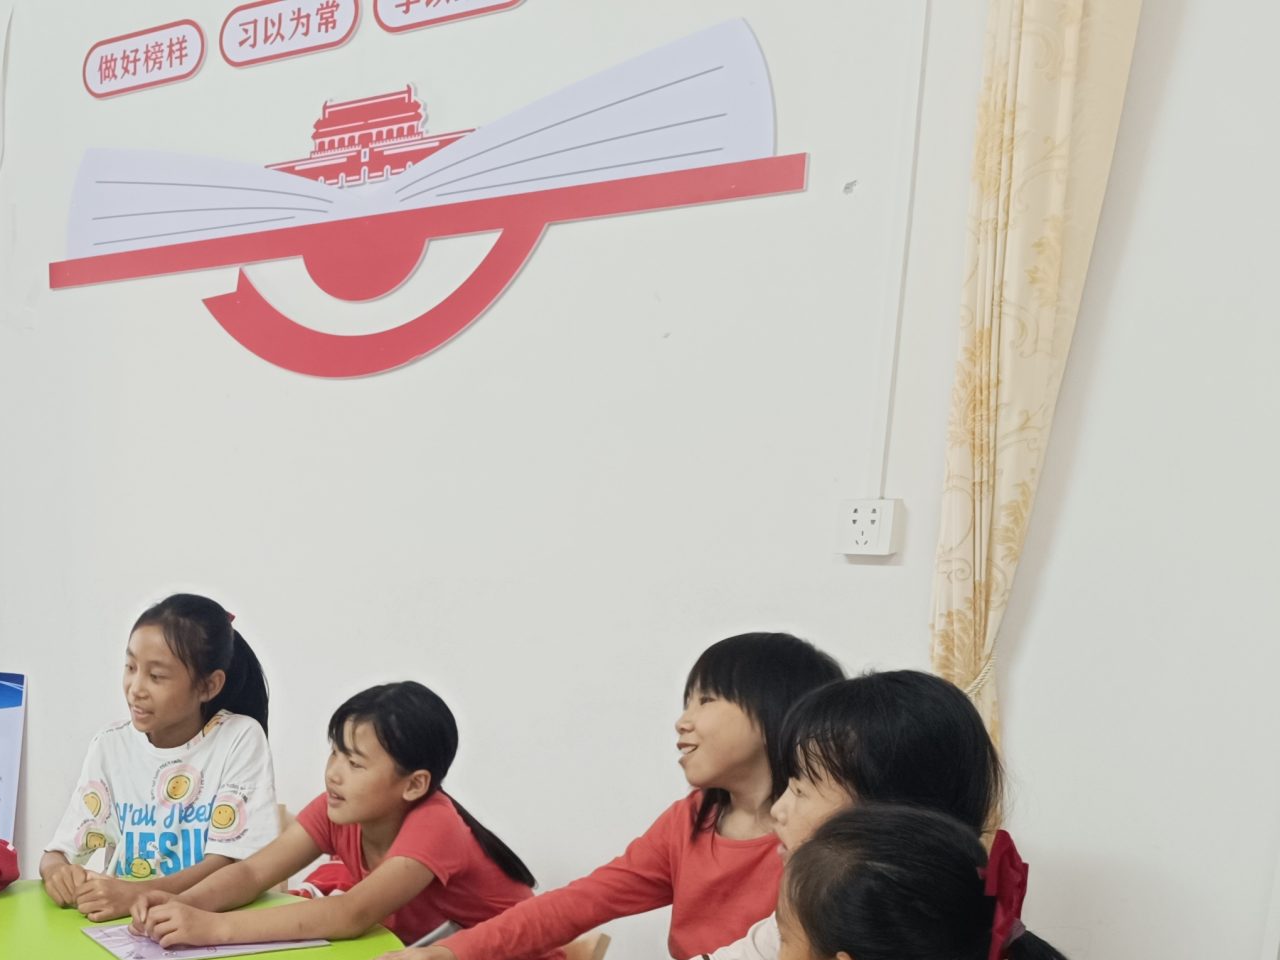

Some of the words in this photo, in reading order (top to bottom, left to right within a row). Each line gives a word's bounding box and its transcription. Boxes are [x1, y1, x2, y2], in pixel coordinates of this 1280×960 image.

[238, 0, 340, 49] 习以为常
[97, 34, 189, 85] 做好榜样
